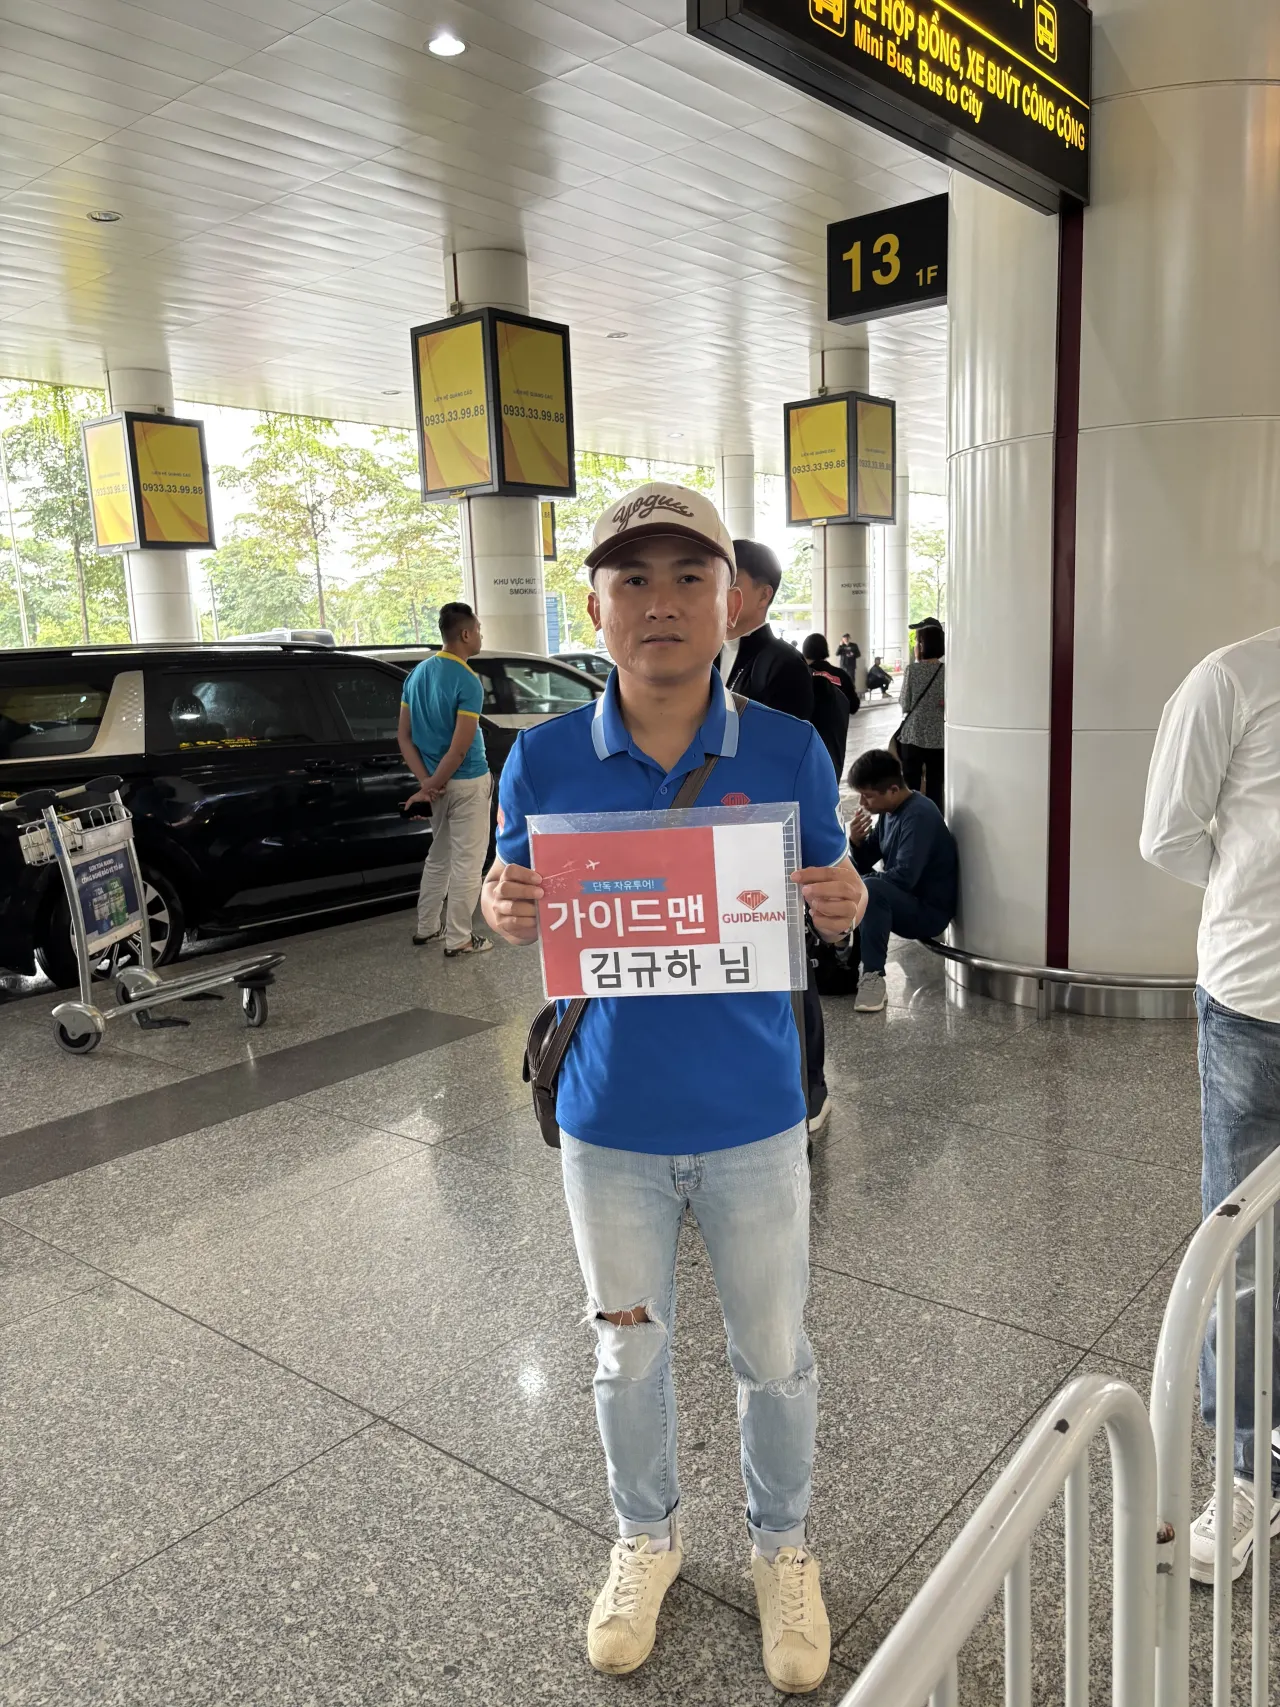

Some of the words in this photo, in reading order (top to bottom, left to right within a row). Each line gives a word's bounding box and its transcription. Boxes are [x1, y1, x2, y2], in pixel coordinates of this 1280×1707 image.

[854, 19, 883, 61] Mini
[886, 39, 916, 85] Bus,
[918, 59, 943, 96] Bus
[946, 77, 958, 104] to
[960, 84, 983, 124] City
[917, 10, 964, 81] ĐỒNG,
[966, 46, 985, 88] XE
[987, 60, 1021, 108] BUÝT
[1021, 83, 1055, 131] CÔNG
[1057, 105, 1085, 151] CỘNG
[842, 233, 900, 292] 13
[915, 265, 938, 287] 1F
[425, 404, 485, 427] 0933.33.99.88
[503, 404, 564, 423] 0933.33.99.88
[792, 459, 846, 474] 0933.33.99.88
[142, 483, 203, 495] 0933.33.99.88
[493, 578, 509, 586] KHU
[510, 577, 524, 586] VỰC
[592, 881, 612, 892] 단독
[614, 879, 655, 891] 자유투어!
[547, 893, 706, 938] 가이드맨
[722, 911, 786, 924] GUIDEMAN
[590, 949, 701, 989] 김규하
[719, 946, 750, 984] 님
